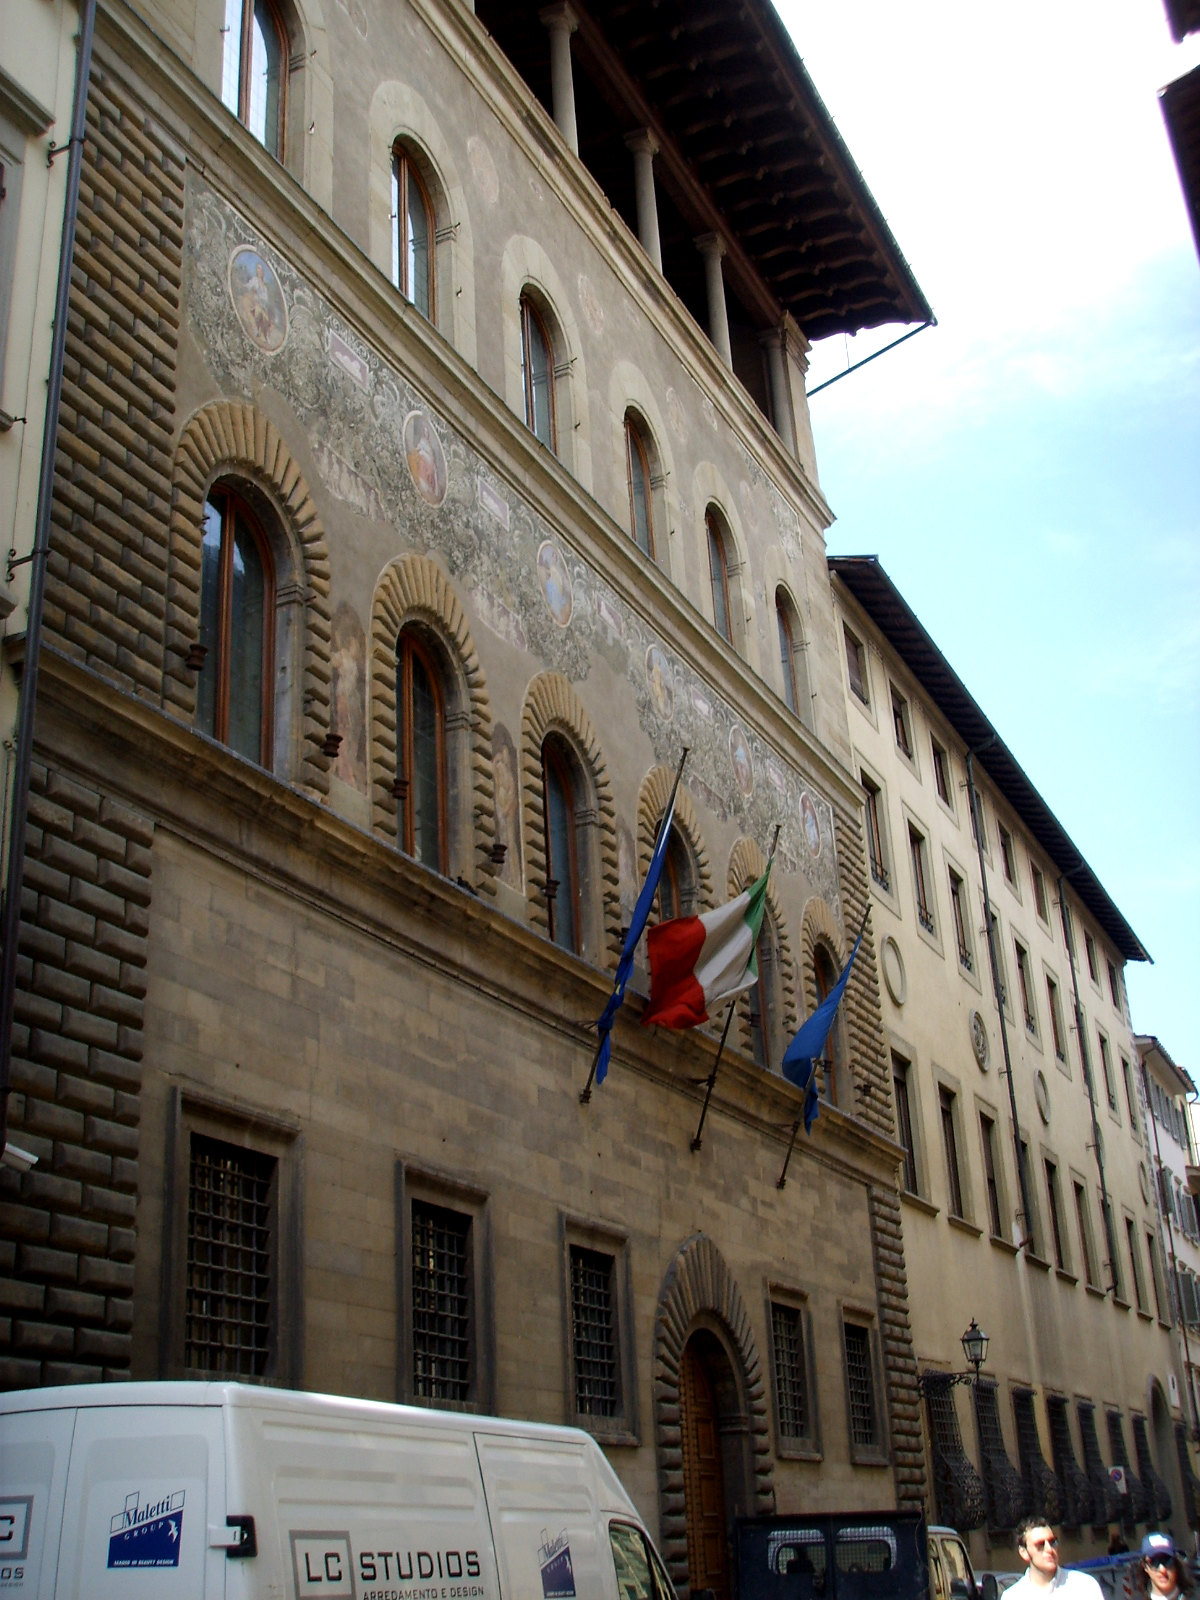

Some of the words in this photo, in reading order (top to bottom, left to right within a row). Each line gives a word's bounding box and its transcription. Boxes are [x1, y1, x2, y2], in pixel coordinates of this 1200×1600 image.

[125, 1495, 170, 1528] Maletti
[0, 1515, 15, 1541] C
[124, 1521, 164, 1540] GROUP
[305, 1552, 342, 1582] LC
[359, 1550, 481, 1581] STUDIOS
[363, 1588, 438, 1600] ARREDAMENTO
[441, 1587, 447, 1598] E
[450, 1585, 485, 1598] DESIGN
